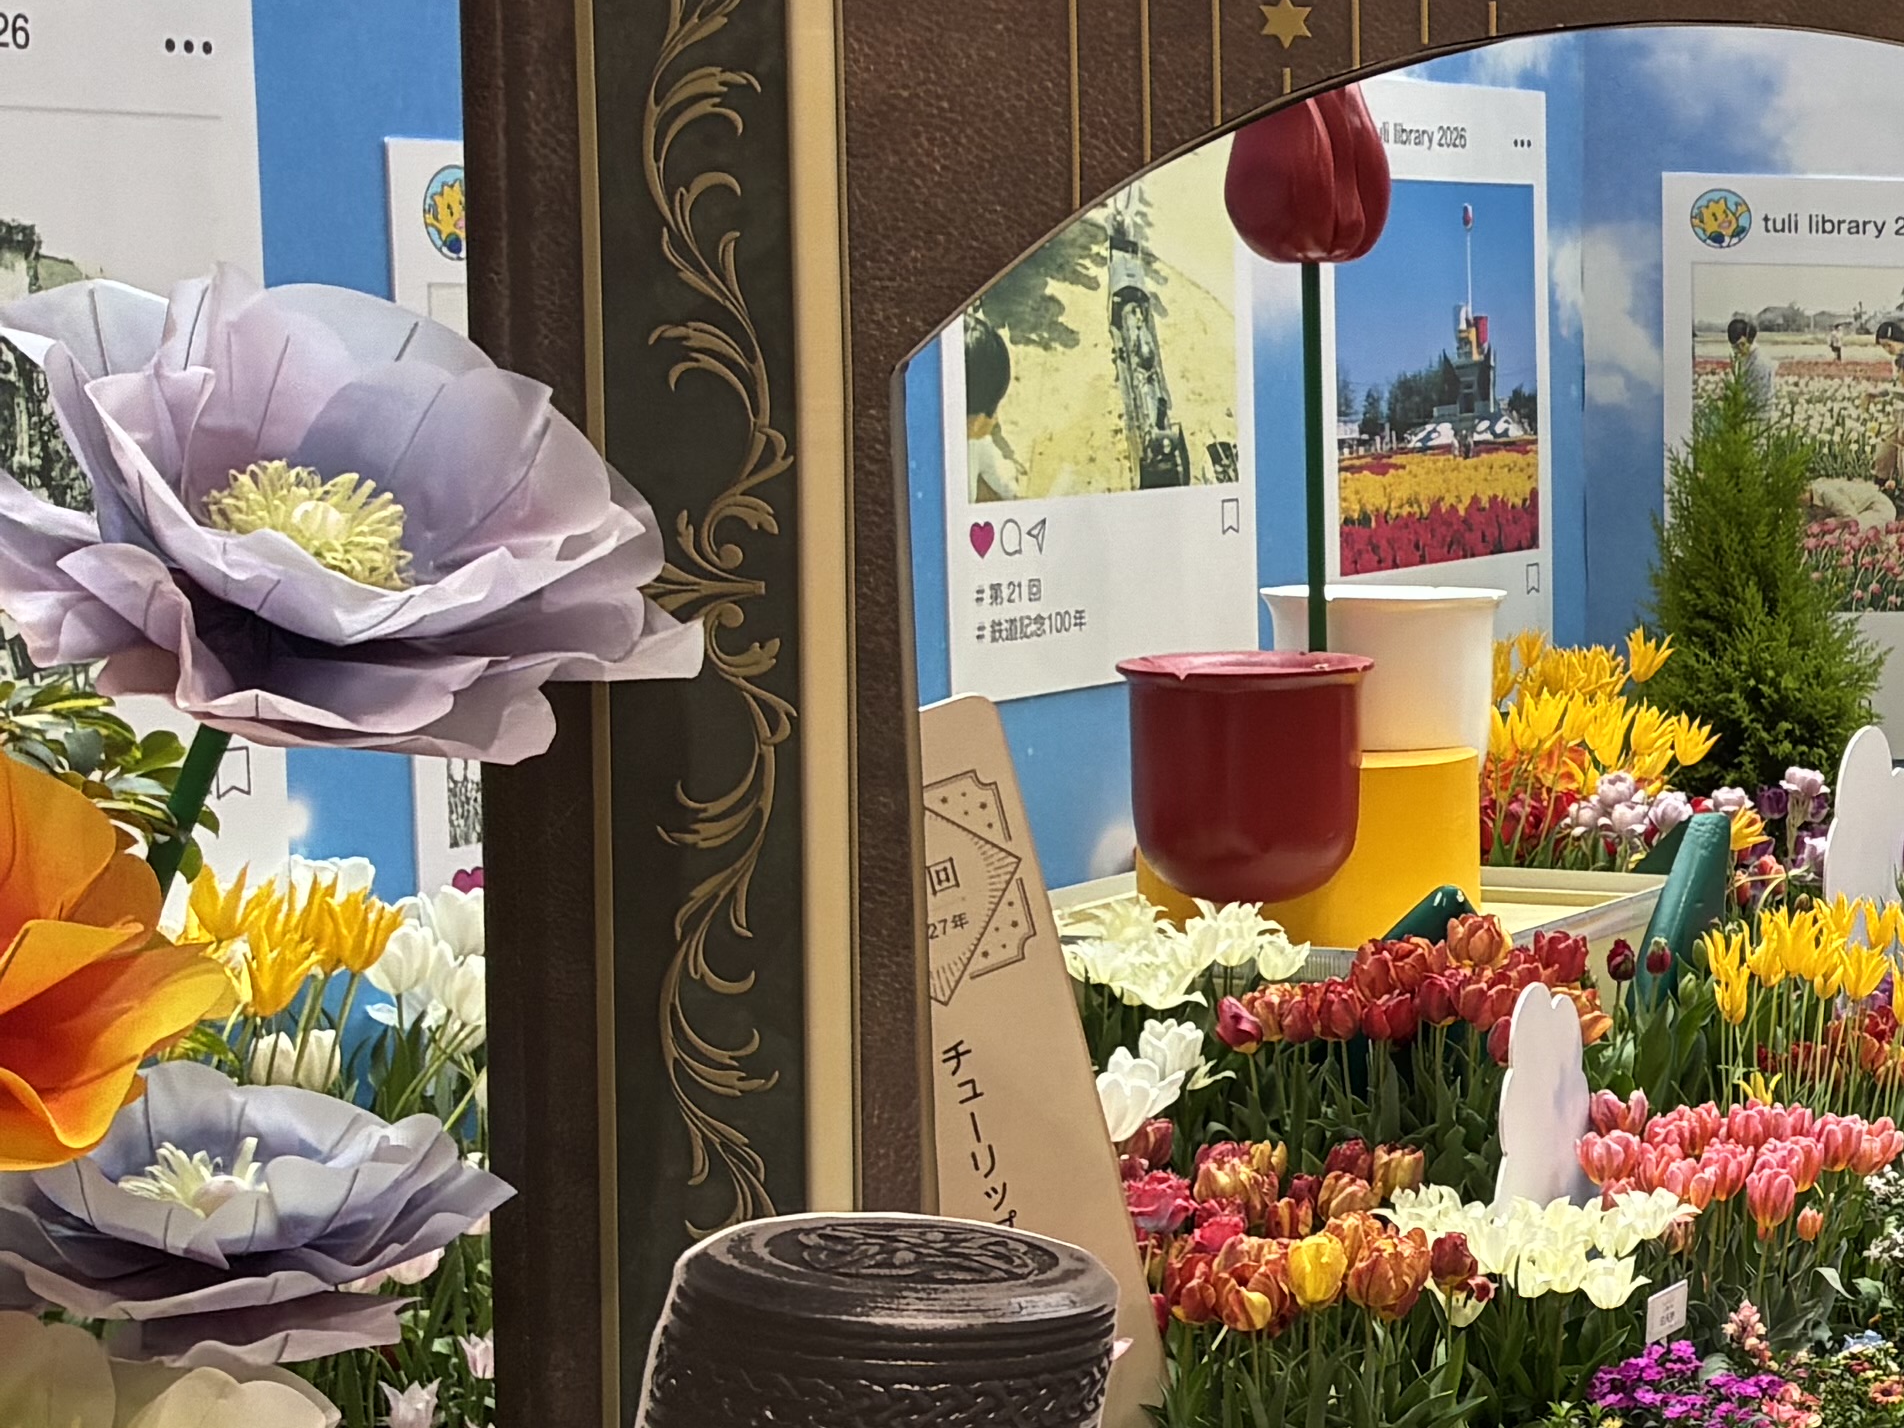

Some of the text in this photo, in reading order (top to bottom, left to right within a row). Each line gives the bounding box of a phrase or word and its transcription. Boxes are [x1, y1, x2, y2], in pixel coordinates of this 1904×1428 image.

[1392, 122, 1434, 150] library
[1437, 125, 1467, 149] 2026
[1762, 213, 1799, 234] tuli
[1808, 213, 1887, 239] library
